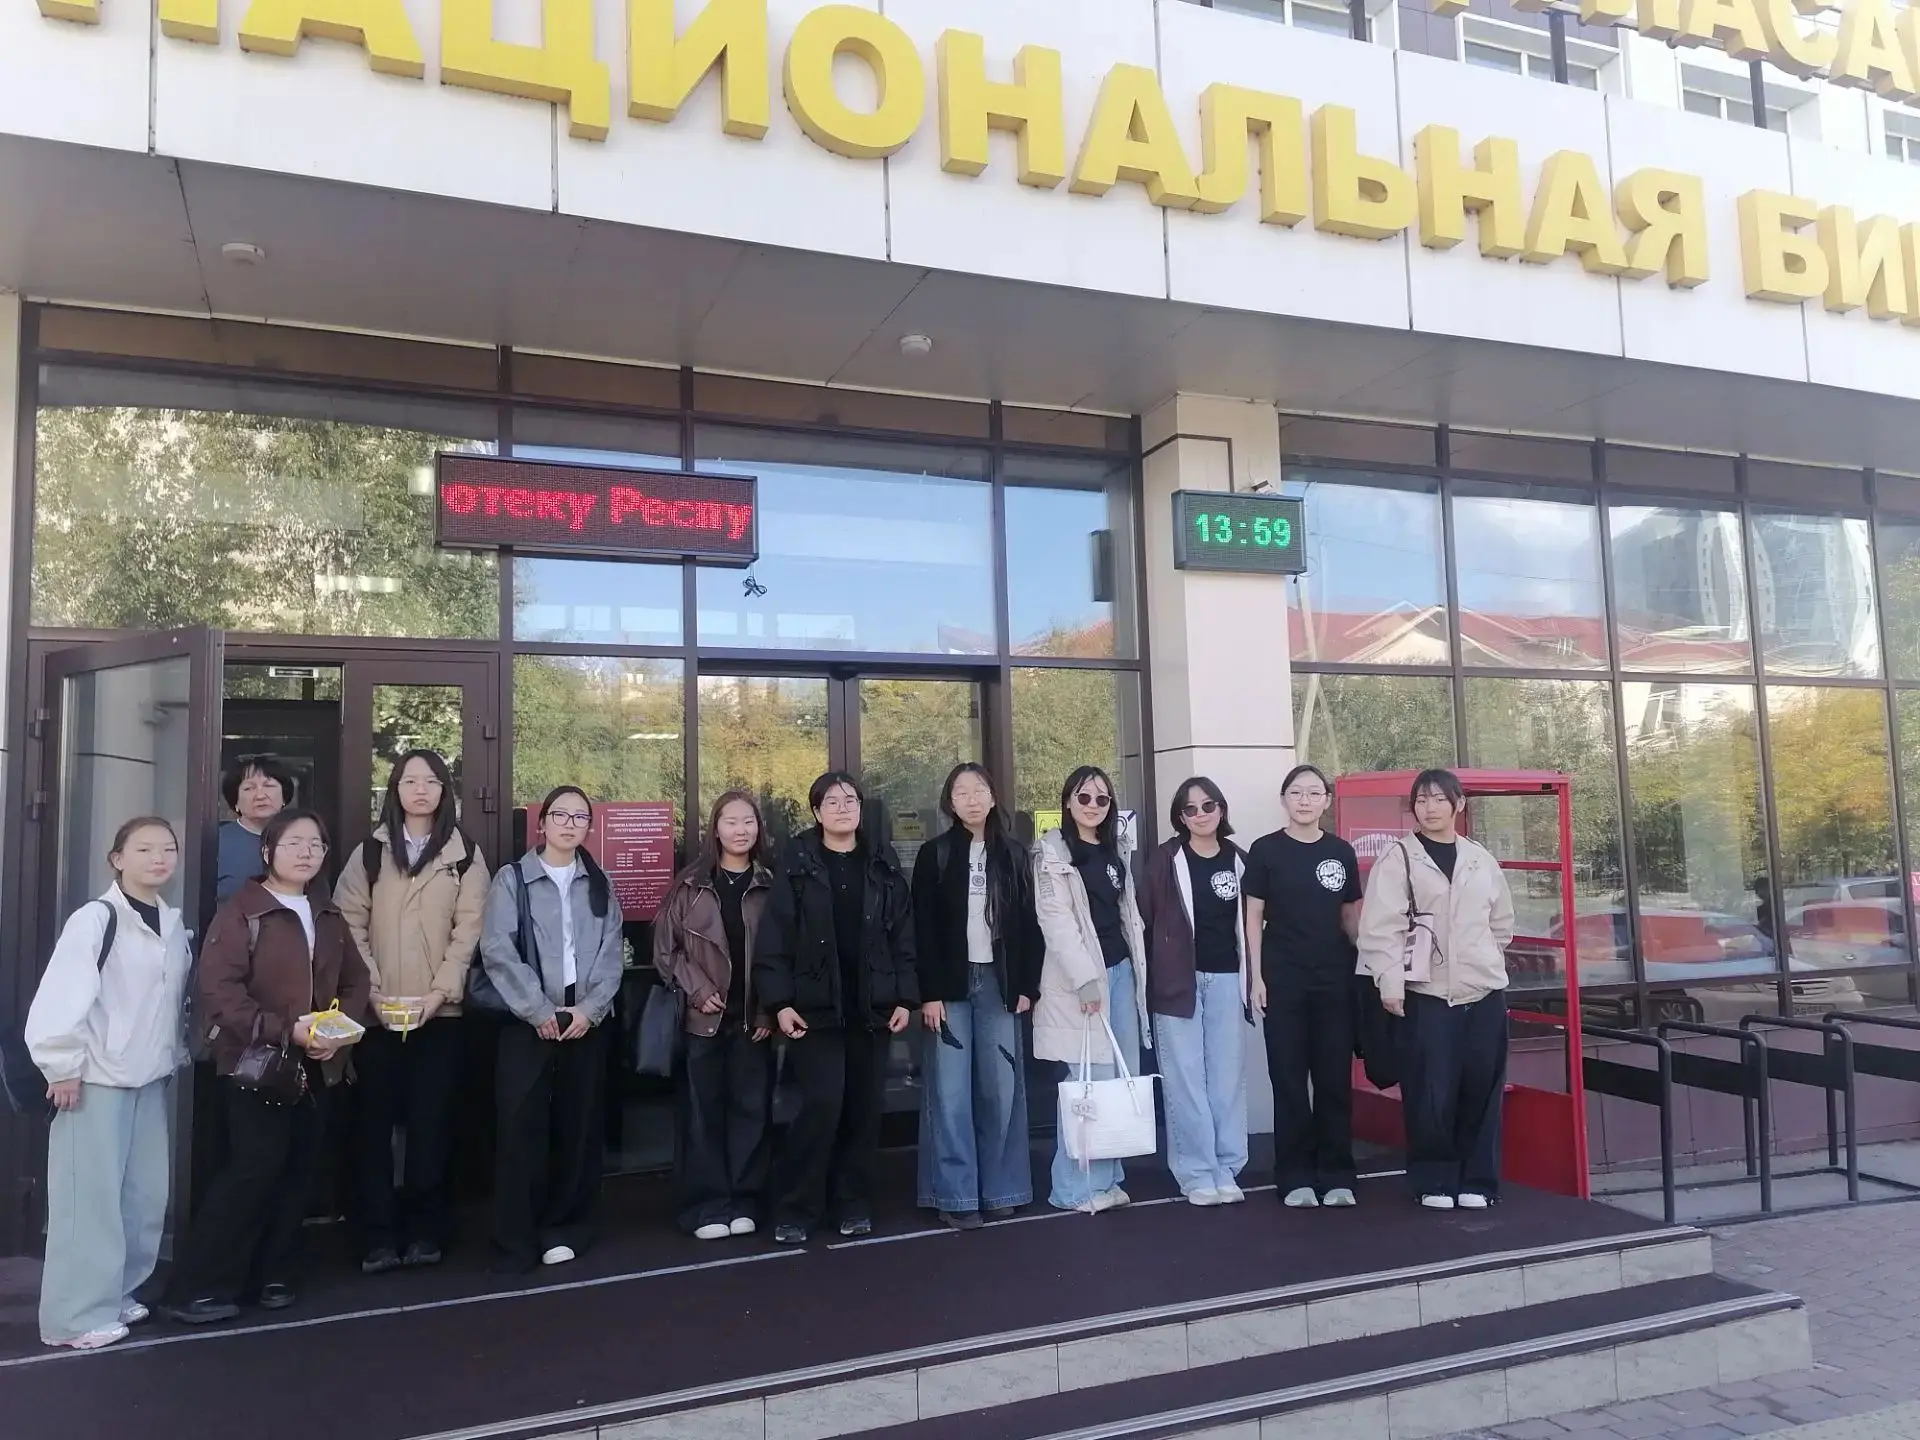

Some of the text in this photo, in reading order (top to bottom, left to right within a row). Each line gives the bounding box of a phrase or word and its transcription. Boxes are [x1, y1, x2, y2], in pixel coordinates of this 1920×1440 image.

[39, 0, 1920, 327] ЦИОНАЛЬНАЯ БИ
[441, 482, 753, 540] отеку Респу
[1195, 513, 1291, 547] 13:59
